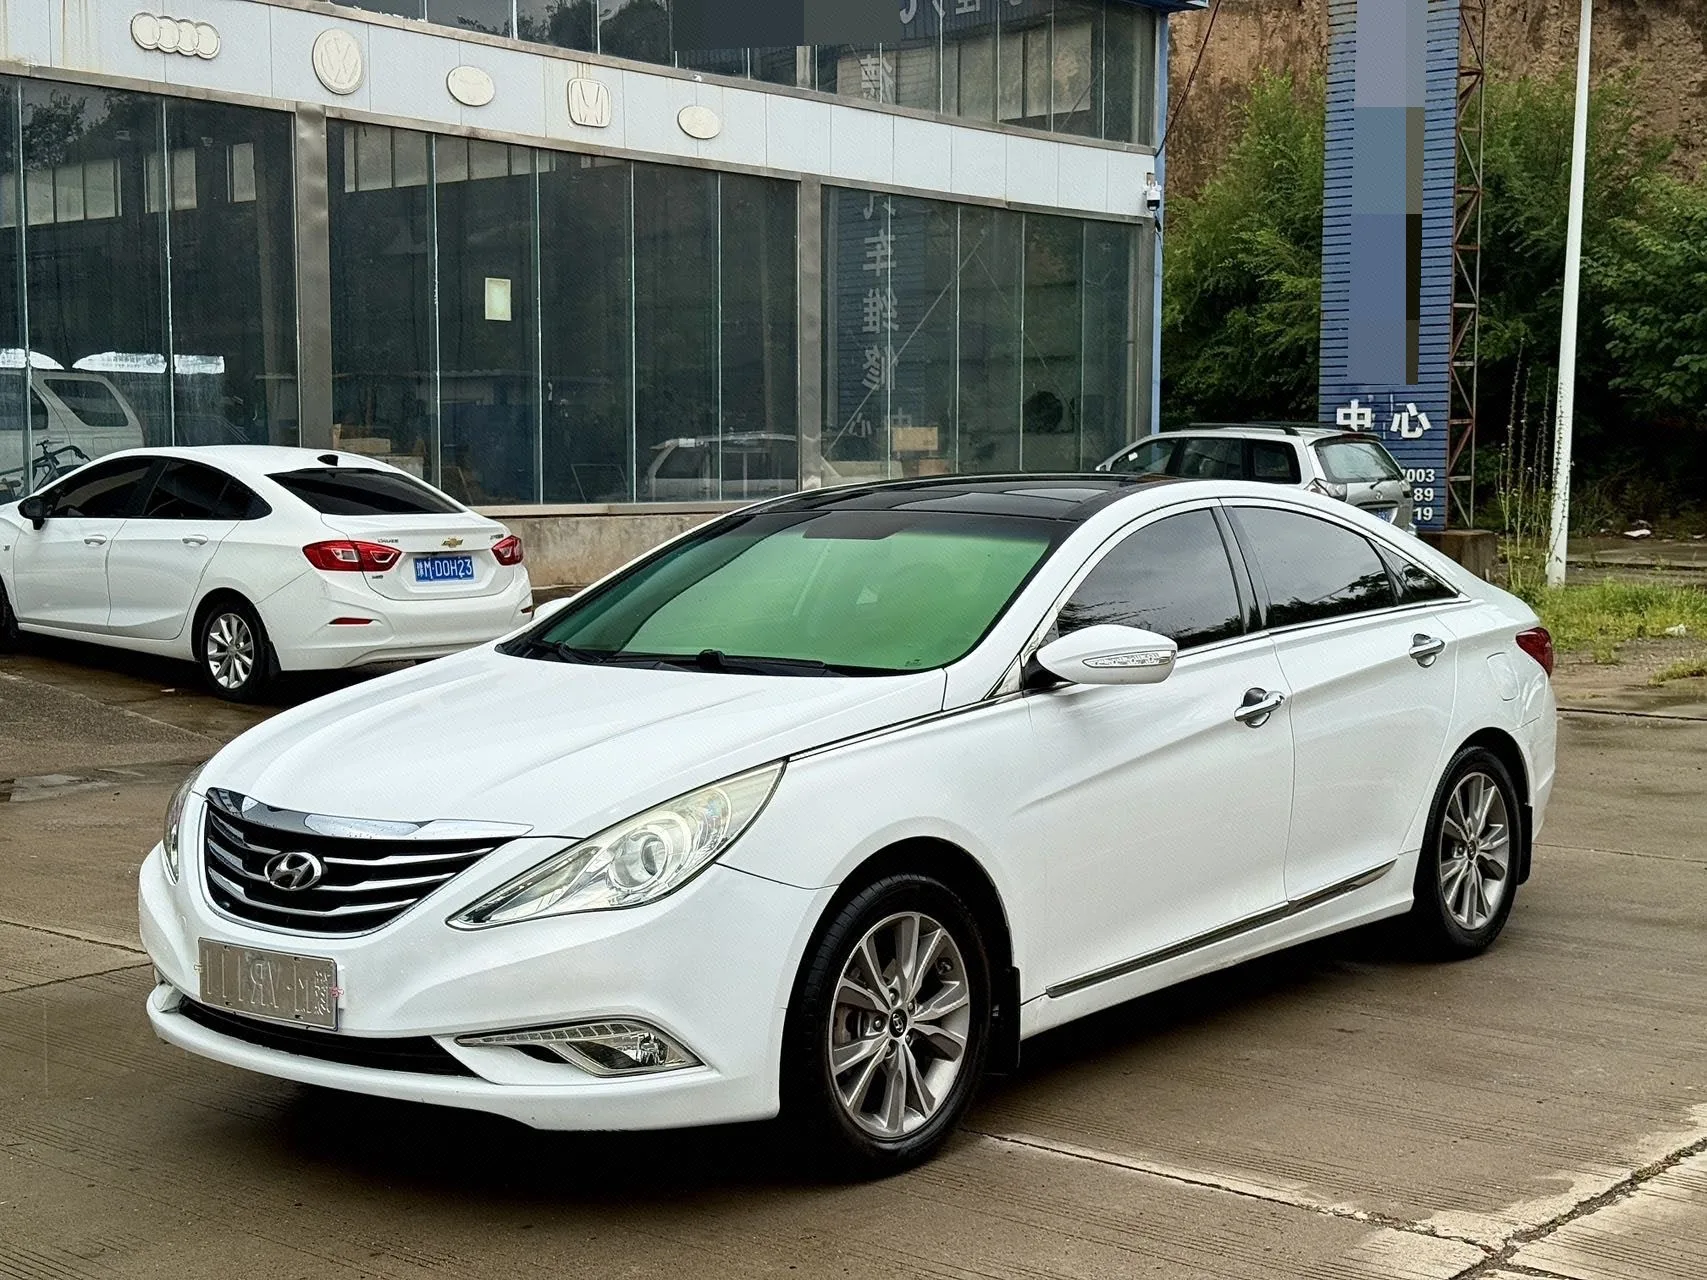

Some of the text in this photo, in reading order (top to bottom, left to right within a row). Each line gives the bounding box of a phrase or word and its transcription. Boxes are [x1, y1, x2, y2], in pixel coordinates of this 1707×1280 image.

[1336, 399, 1432, 439] 中心
[1413, 487, 1434, 502] 89
[1412, 506, 1433, 521] 19
